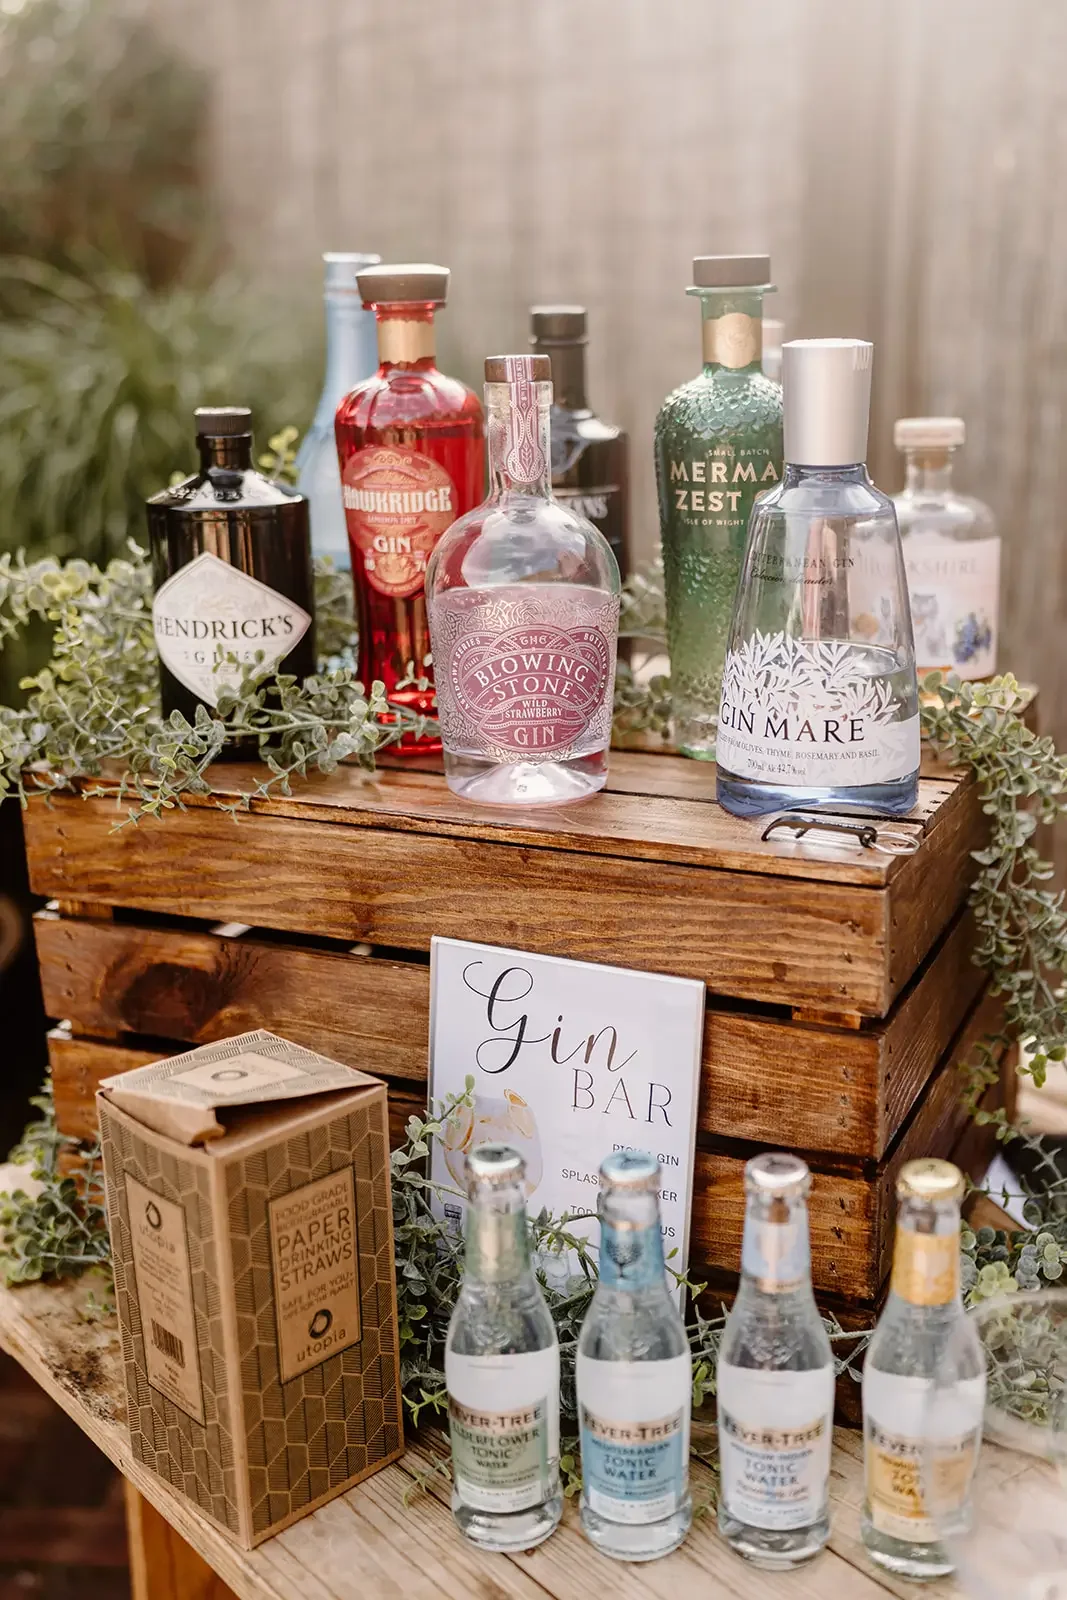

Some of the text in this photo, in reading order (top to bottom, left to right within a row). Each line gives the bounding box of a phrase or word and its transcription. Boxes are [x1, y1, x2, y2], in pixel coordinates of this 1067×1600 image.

[708, 448, 770, 456] SMALL BATCH
[670, 460, 785, 483] MERMA
[675, 489, 742, 512] ZEST
[716, 518, 744, 526] WIGHT
[373, 535, 412, 553] GIN
[833, 557, 856, 569] GIN
[156, 615, 293, 640] HENDRICK'S
[455, 637, 481, 659] SERIES
[519, 636, 548, 646] THE
[583, 633, 607, 669] BOTTLING
[474, 653, 590, 688] BLOWING
[452, 661, 471, 710] ASHDOWN
[493, 676, 574, 702] STONE
[505, 707, 563, 719] STRAWBERRY
[522, 699, 548, 708] WILD
[721, 702, 865, 744] GIN MARE
[513, 726, 556, 746] GIN
[795, 749, 839, 760] ROSEMARY
[839, 751, 856, 760] AND
[462, 961, 638, 1074] Gin
[571, 1067, 673, 1127] BAR
[656, 1153, 680, 1166] GIN
[276, 1182, 349, 1221] FOOD GRADE
[277, 1207, 351, 1257] PAPER
[279, 1227, 352, 1273] DRINKING
[280, 1242, 353, 1292] STRAWS
[307, 1283, 328, 1299] FOR
[297, 1328, 347, 1363] utopia
[471, 1445, 513, 1460] TONIC
[603, 1454, 656, 1468] TONIC
[603, 1467, 657, 1481] WATER
[744, 1458, 797, 1474] TONIC
